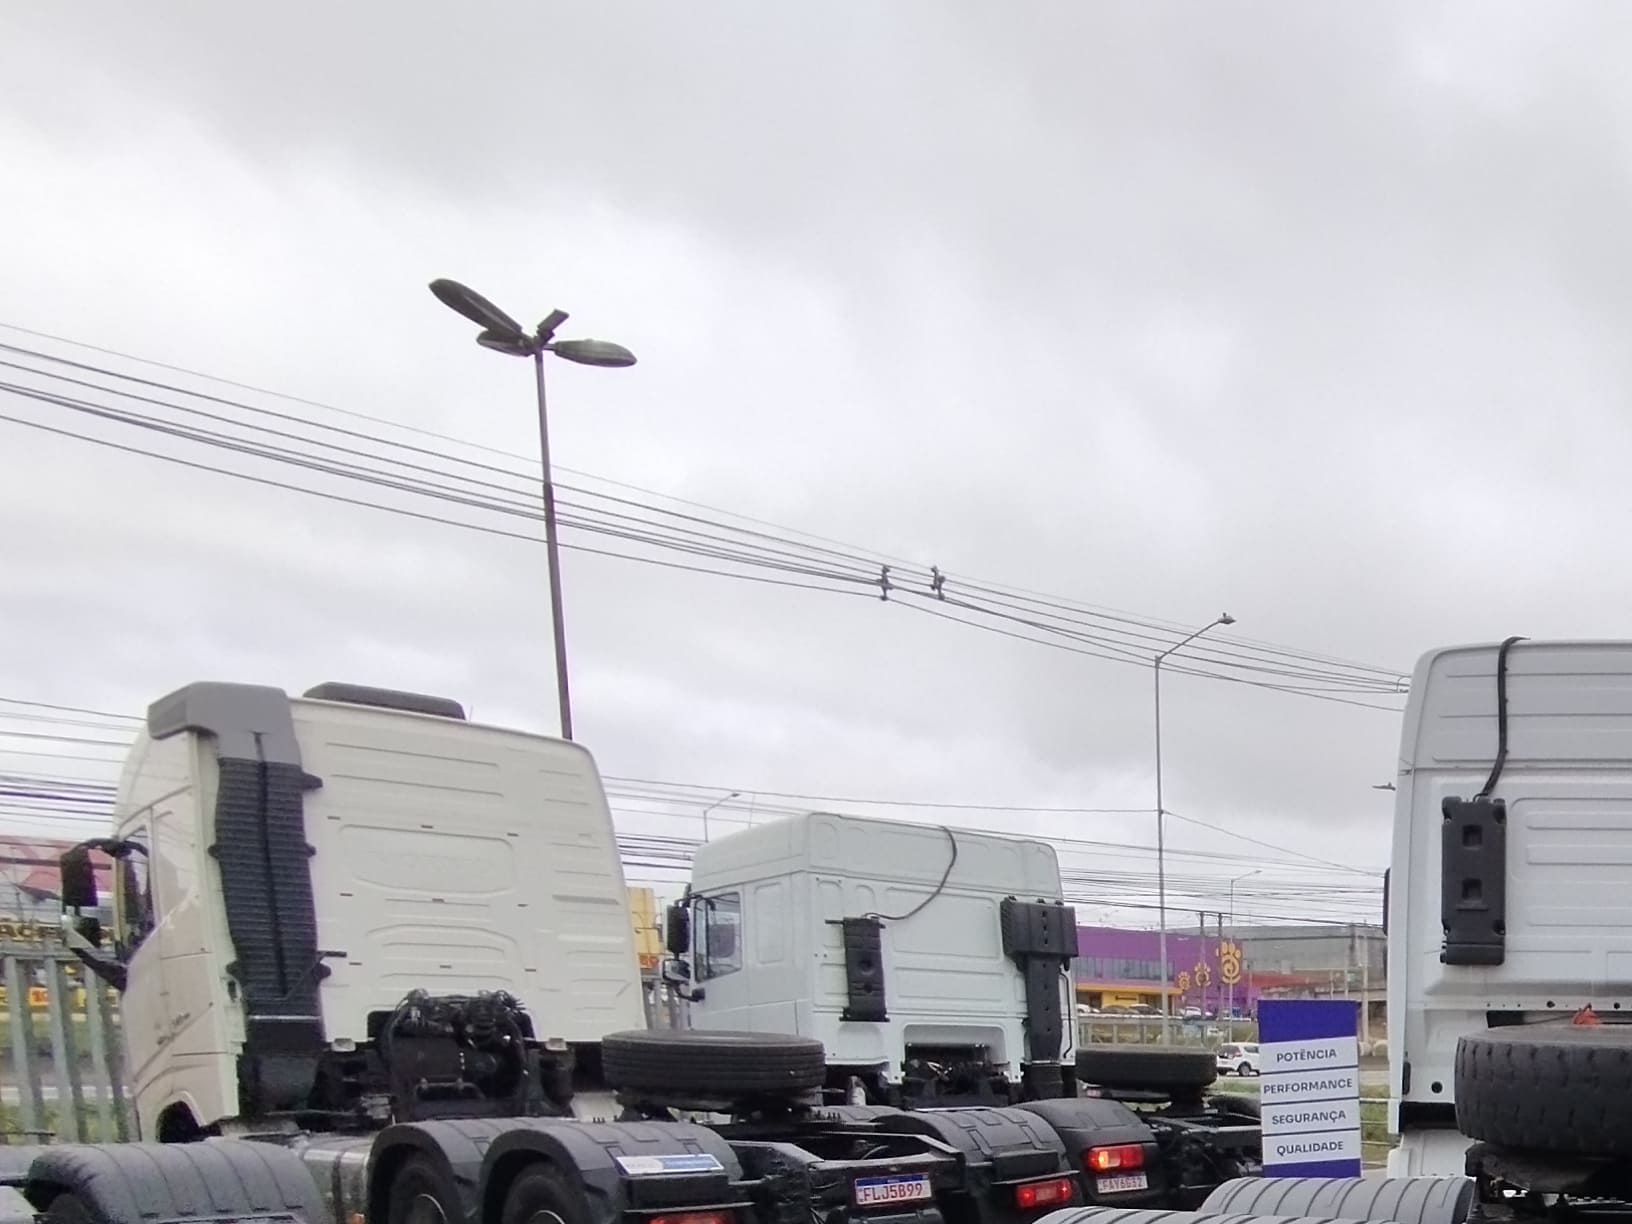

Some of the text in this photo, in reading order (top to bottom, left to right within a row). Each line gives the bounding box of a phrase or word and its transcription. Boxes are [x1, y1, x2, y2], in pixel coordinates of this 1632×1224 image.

[1276, 1048, 1337, 1063] POTÊNCIA
[1263, 1078, 1353, 1095] PERFORMANCE
[1272, 1110, 1347, 1126] SEGURANÇA
[1276, 1140, 1344, 1157] QUALIDADE
[863, 1182, 923, 1202] FLJ5B99
